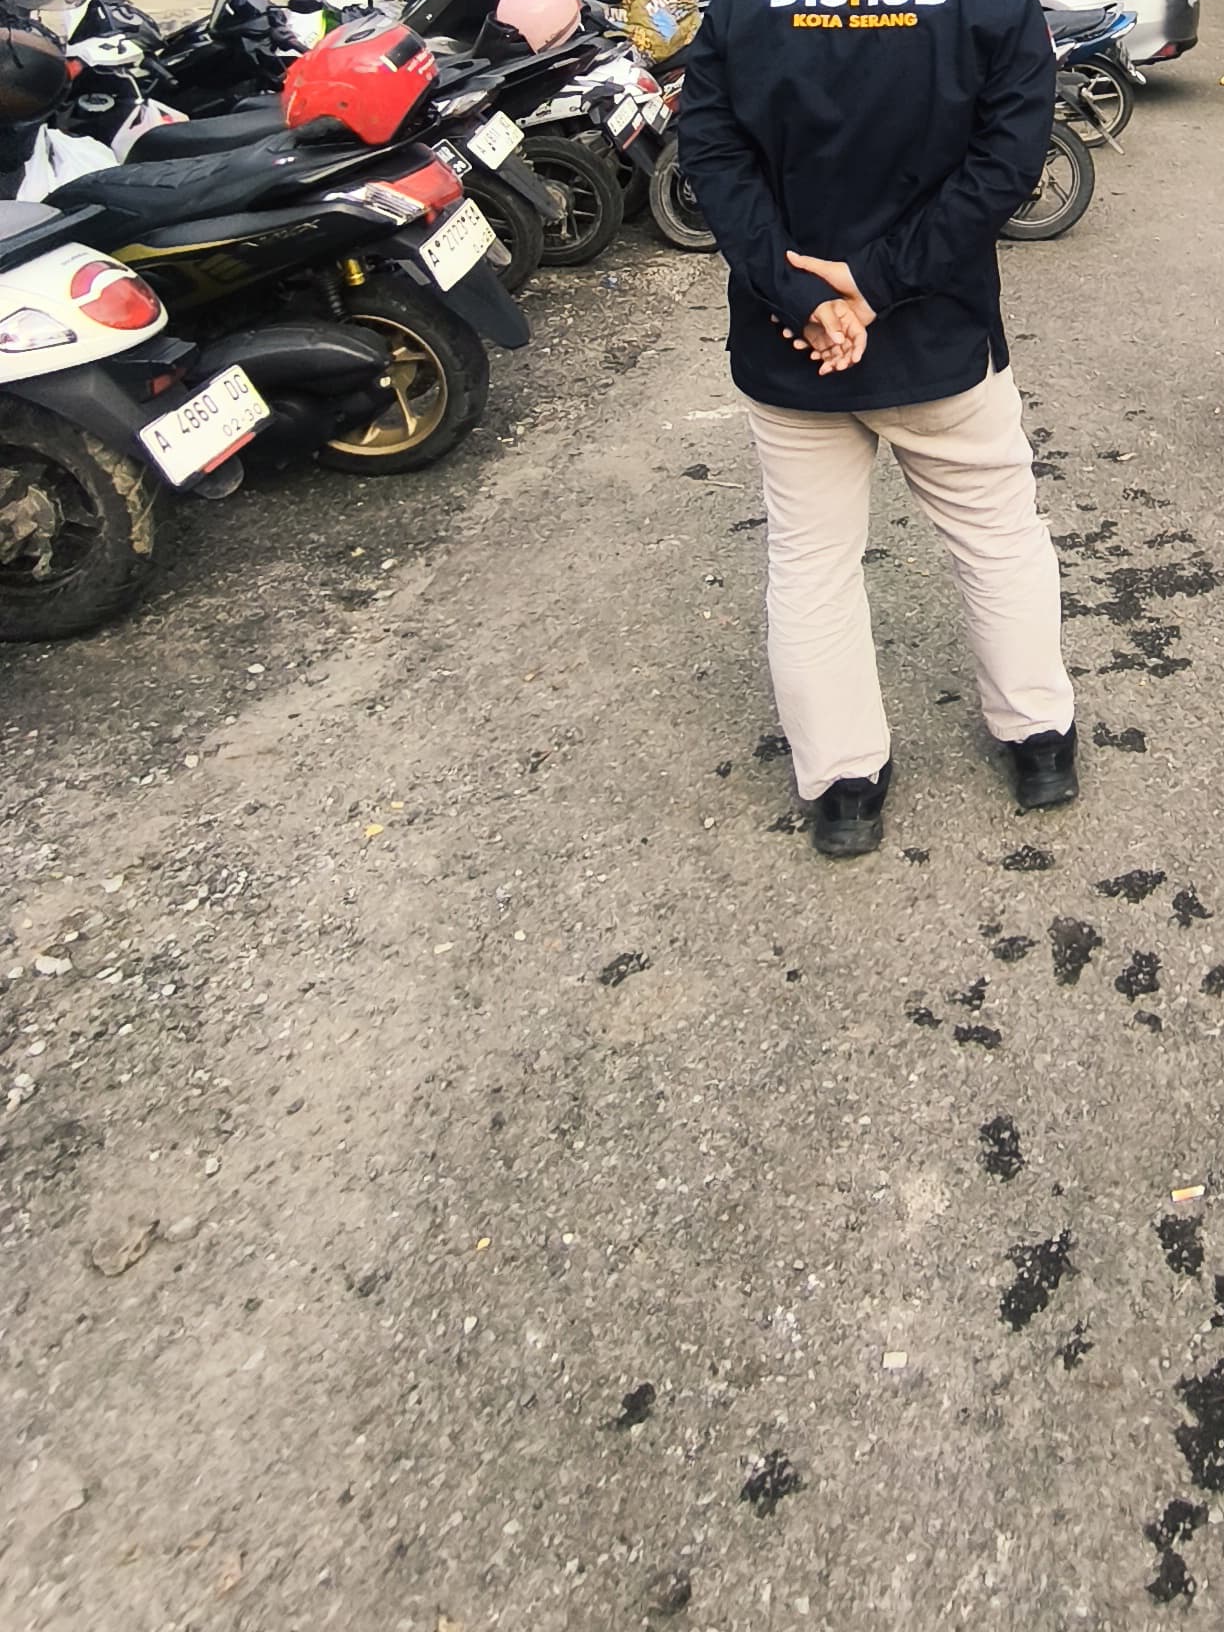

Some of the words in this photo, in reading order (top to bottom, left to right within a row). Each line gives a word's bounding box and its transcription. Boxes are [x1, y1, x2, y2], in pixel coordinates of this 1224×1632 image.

[793, 13, 843, 28] KOTA
[849, 12, 918, 28] SERANG
[428, 249, 440, 268] A
[154, 430, 172, 453] A
[177, 394, 218, 435] 4860
